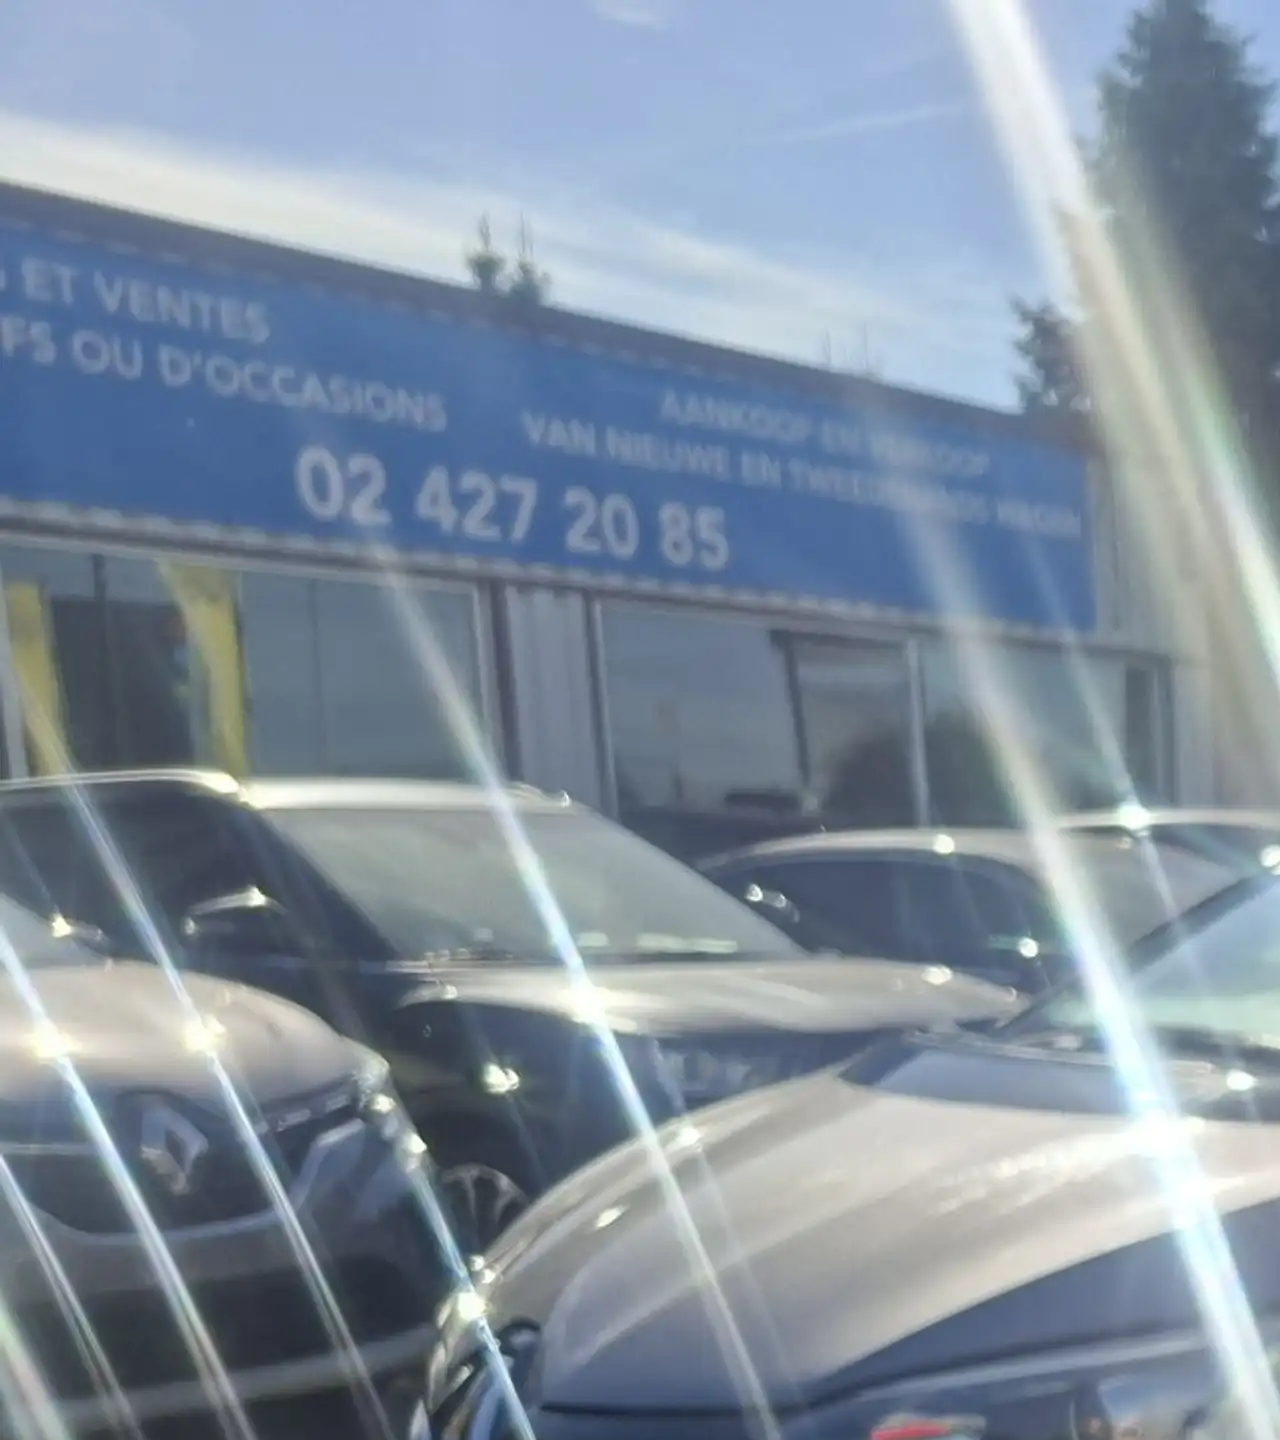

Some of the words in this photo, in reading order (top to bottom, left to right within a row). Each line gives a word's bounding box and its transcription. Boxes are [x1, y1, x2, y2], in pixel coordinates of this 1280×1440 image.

[21, 256, 77, 304] ET
[93, 268, 271, 344] VENTES
[71, 329, 143, 380] OU
[158, 343, 447, 433] D'OCCASIONS
[659, 387, 811, 444] AANKOOP
[521, 407, 598, 456] VAN
[605, 424, 732, 482] NIEUWE
[740, 449, 782, 489] EN
[294, 445, 392, 528] 02
[415, 465, 539, 544] 427
[564, 485, 641, 560] 20
[657, 502, 731, 572] 85
